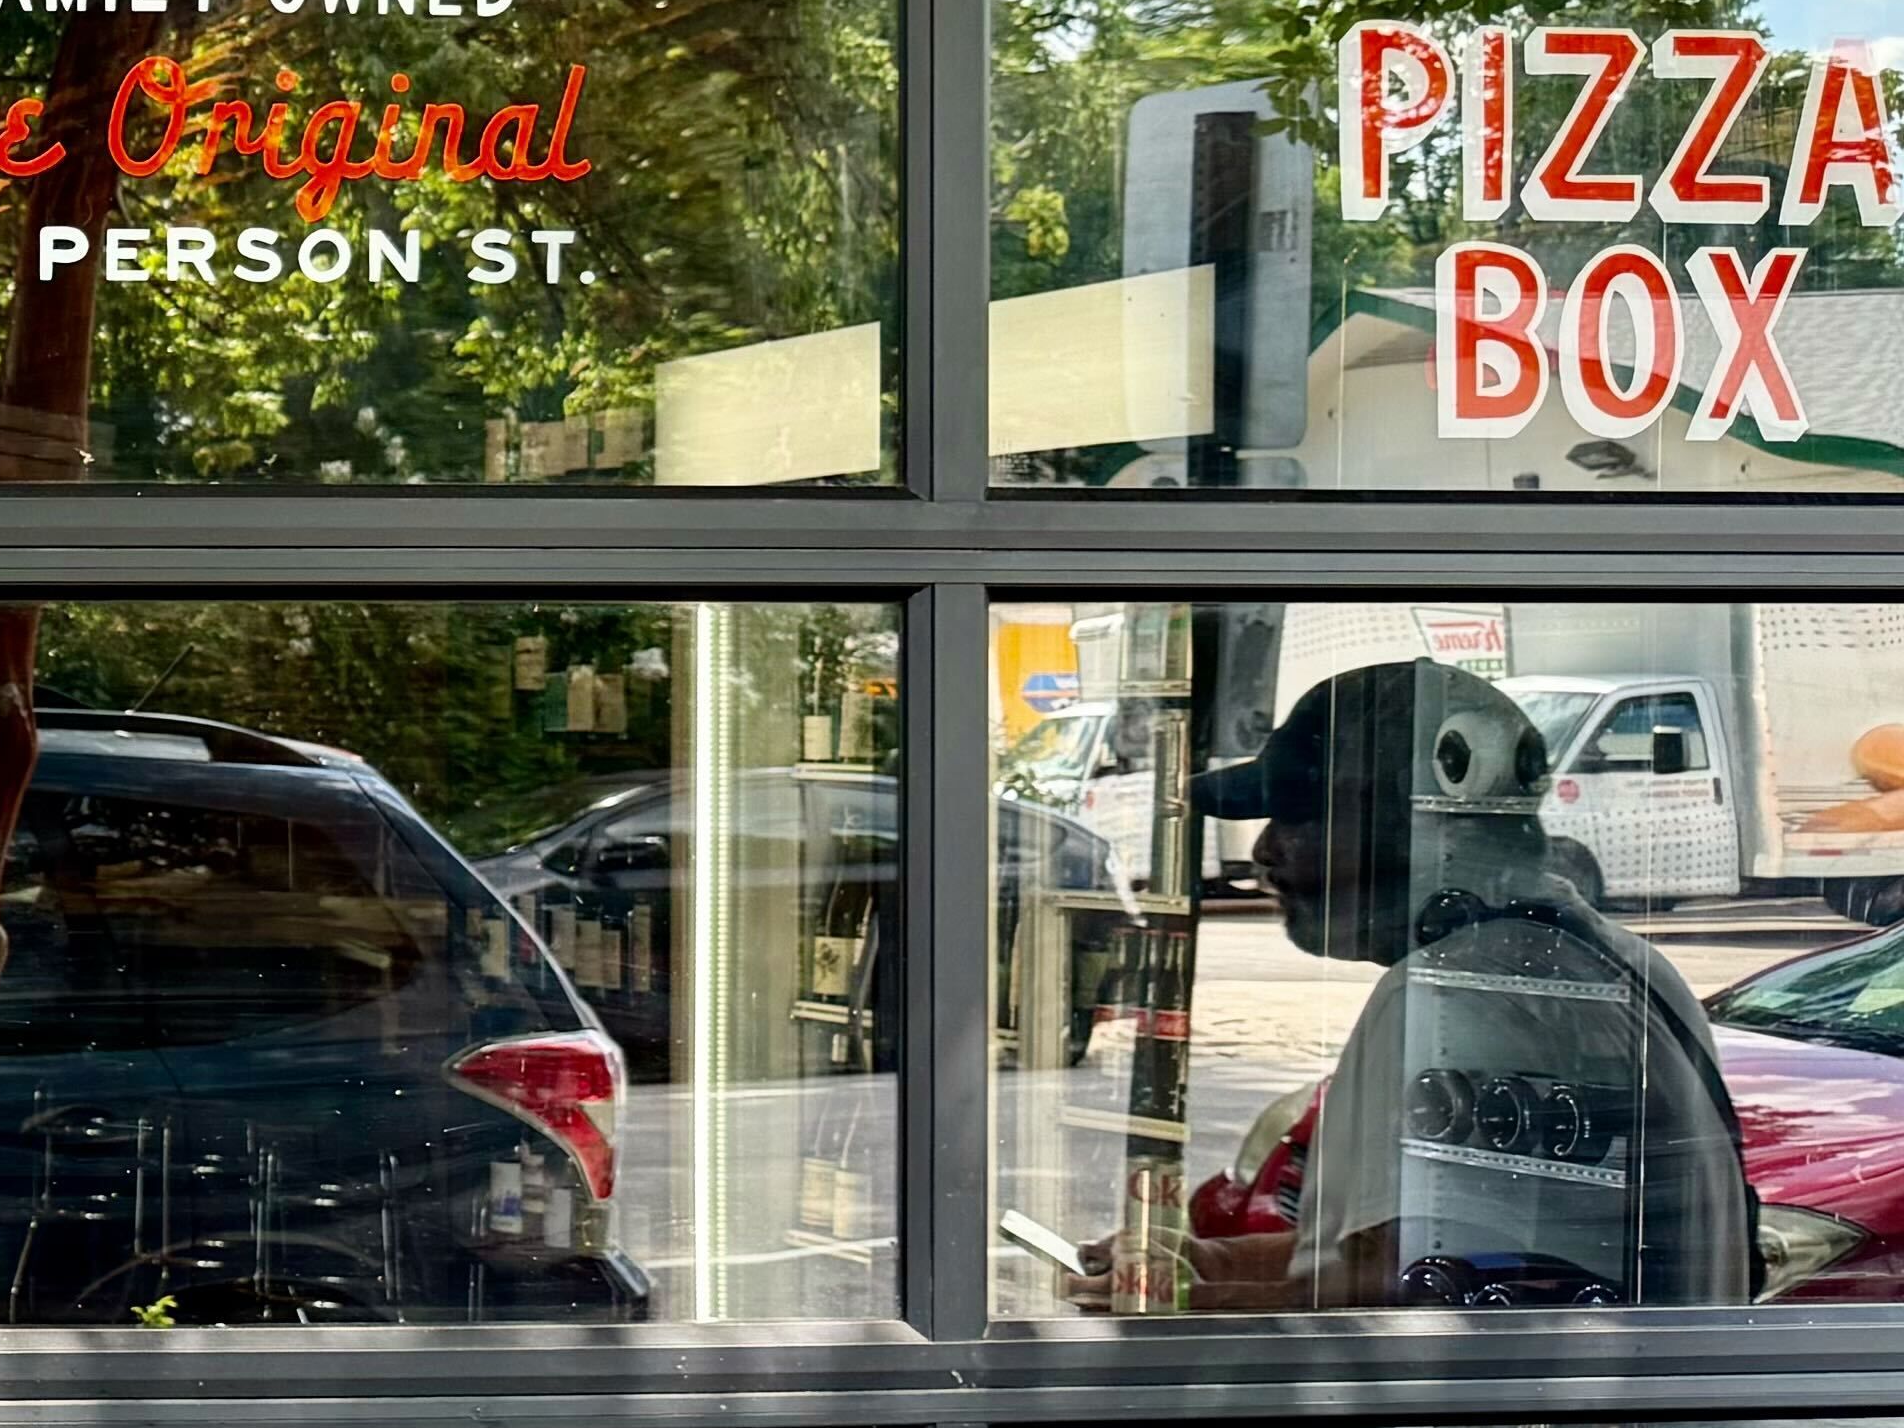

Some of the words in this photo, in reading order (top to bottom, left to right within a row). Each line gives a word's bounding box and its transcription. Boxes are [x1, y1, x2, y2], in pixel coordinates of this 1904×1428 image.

[106, 54, 593, 224] Original
[1338, 19, 1904, 227] PIZZA
[37, 224, 420, 284] PERSON
[468, 229, 596, 286] ST.
[1434, 240, 1810, 443] BOX
